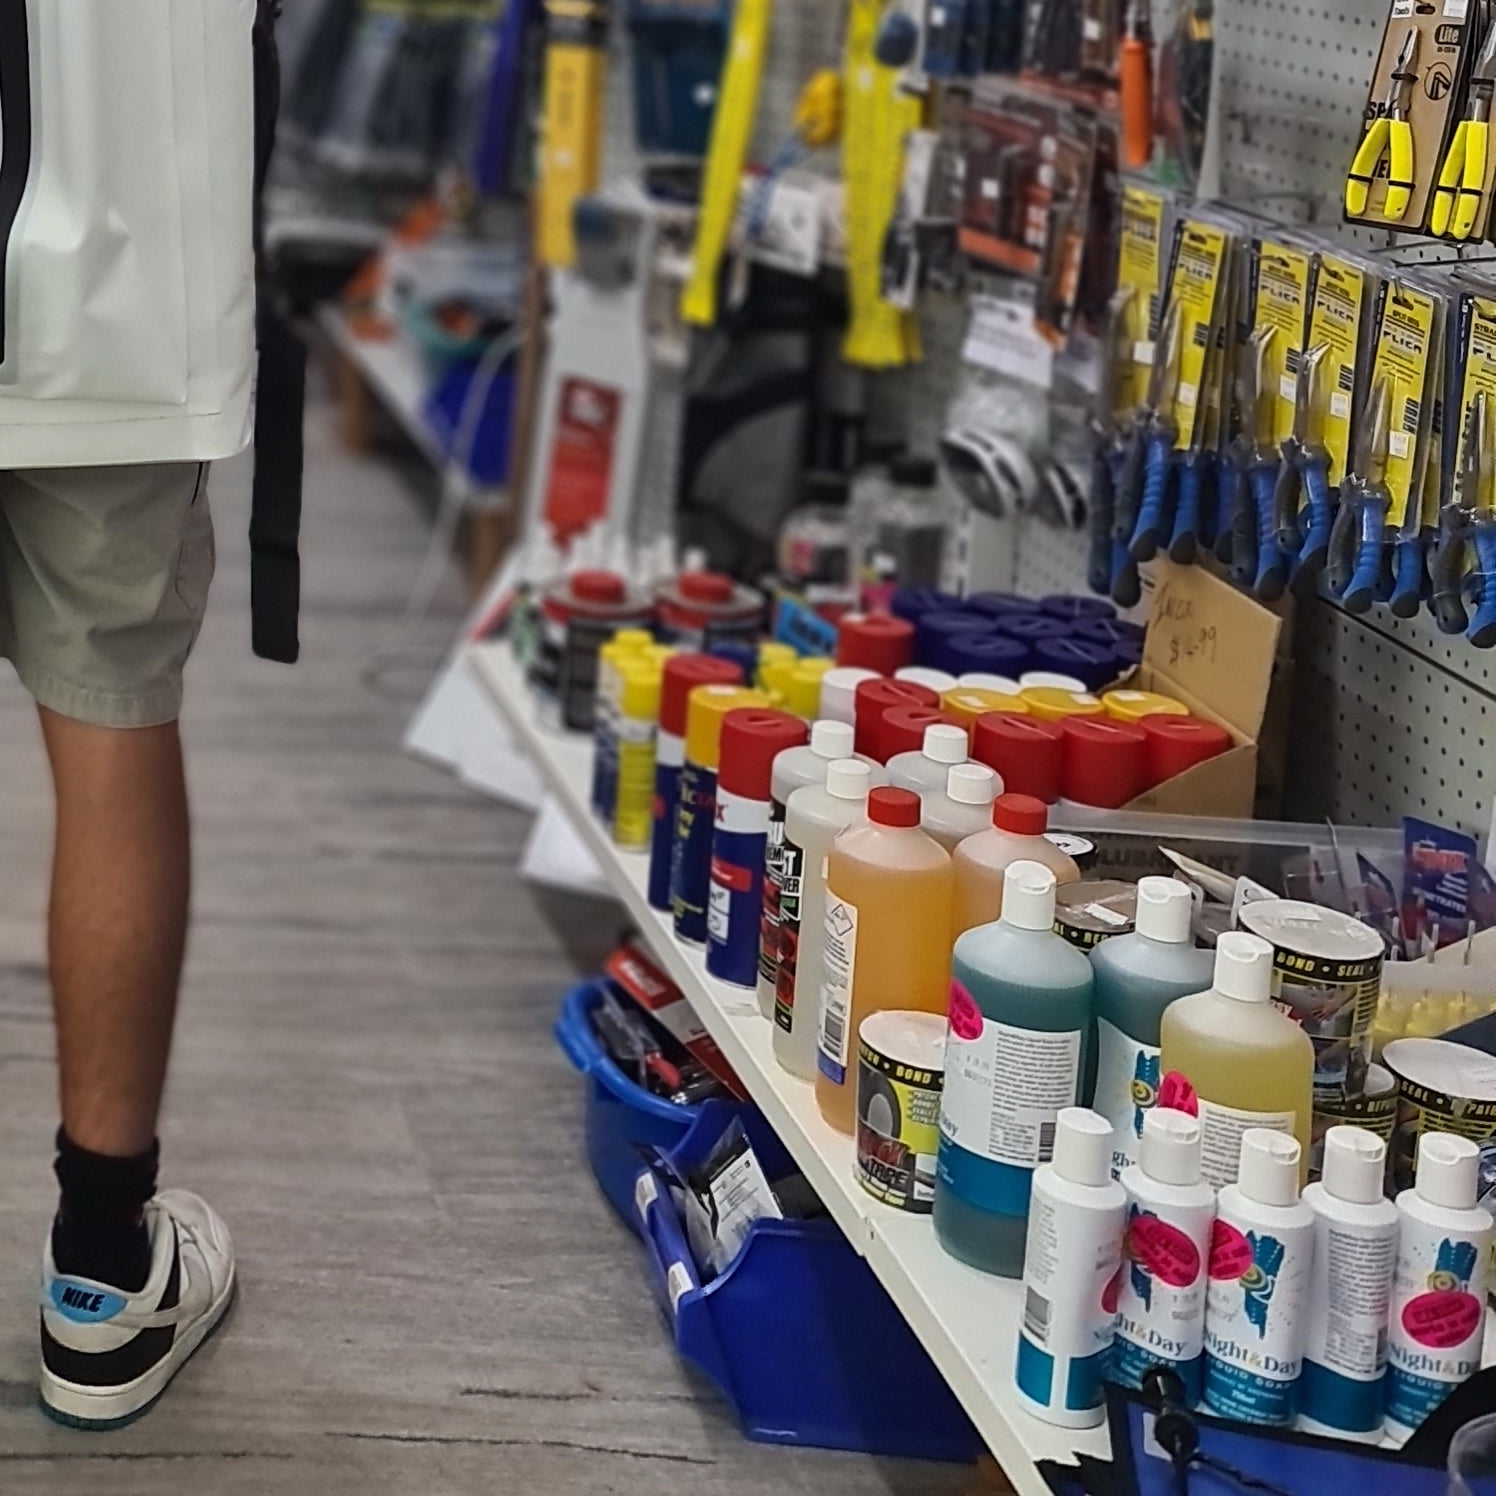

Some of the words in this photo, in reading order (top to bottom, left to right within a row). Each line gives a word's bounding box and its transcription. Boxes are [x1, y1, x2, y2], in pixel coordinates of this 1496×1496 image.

[1438, 25, 1459, 44] Lite
[1276, 951, 1316, 972] BOND
[895, 1065, 932, 1085] BOND
[1401, 1081, 1428, 1102] SEAL
[61, 1286, 105, 1313] NIKE
